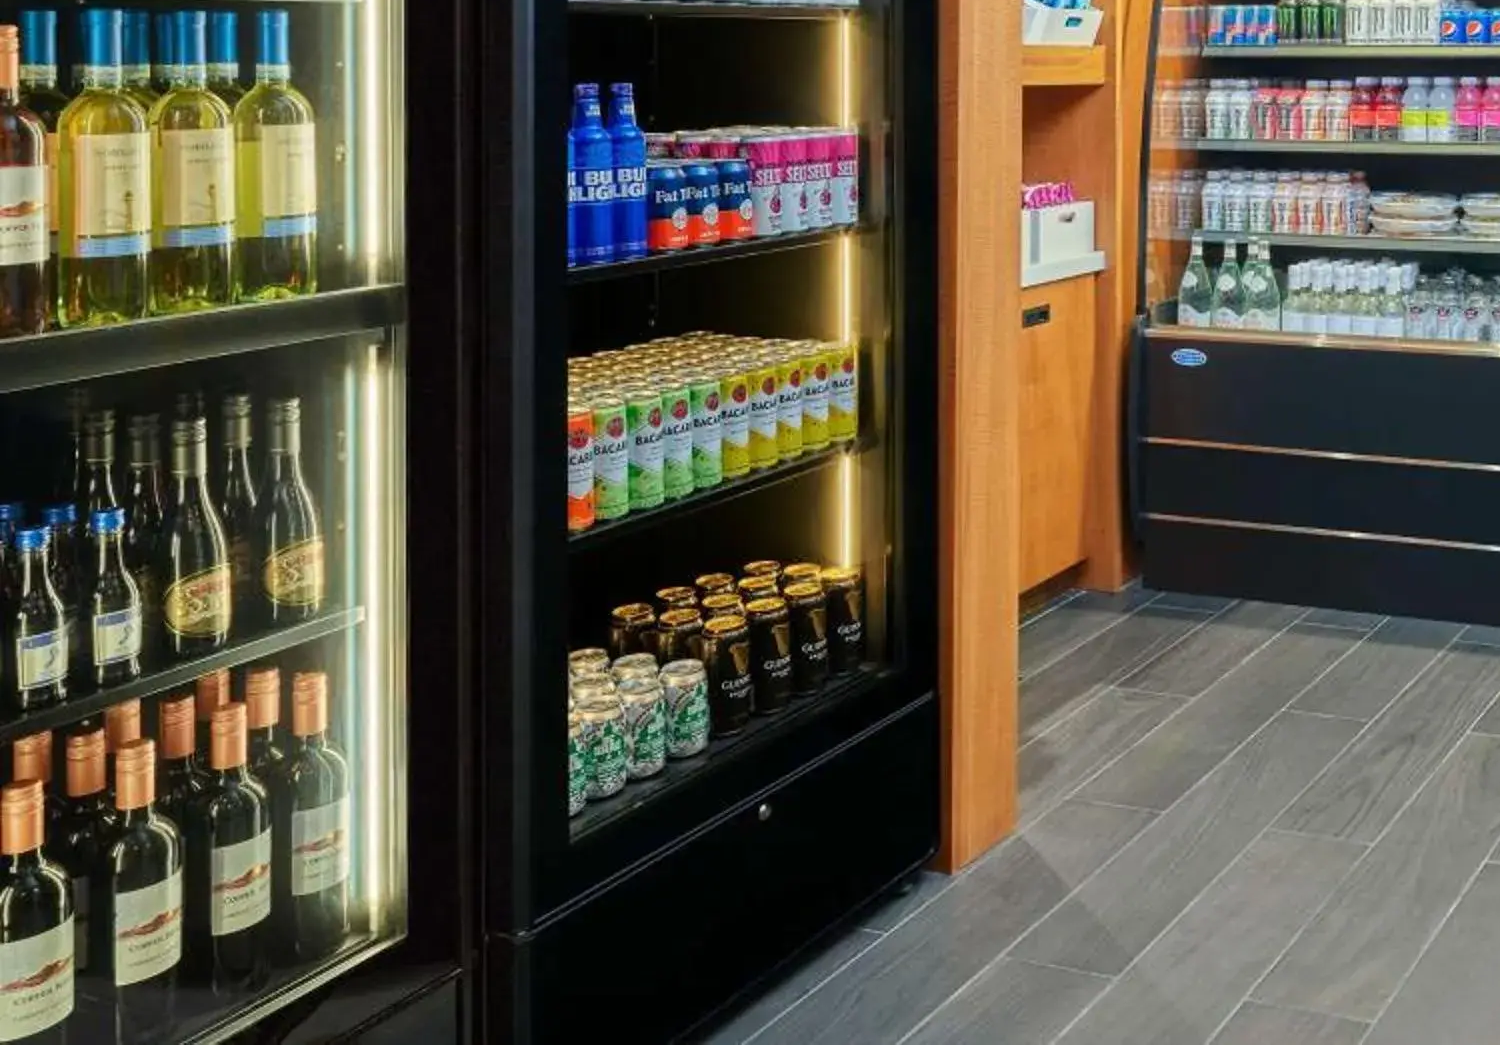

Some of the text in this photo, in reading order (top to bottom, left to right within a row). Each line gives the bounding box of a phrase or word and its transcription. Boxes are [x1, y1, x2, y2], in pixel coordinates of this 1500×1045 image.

[584, 169, 613, 186] BU
[617, 166, 646, 183] BU
[578, 184, 612, 202] LIG
[611, 182, 646, 199] LIG
[655, 189, 678, 203] Fat
[687, 185, 708, 201] Fat
[725, 182, 745, 195] Fat
